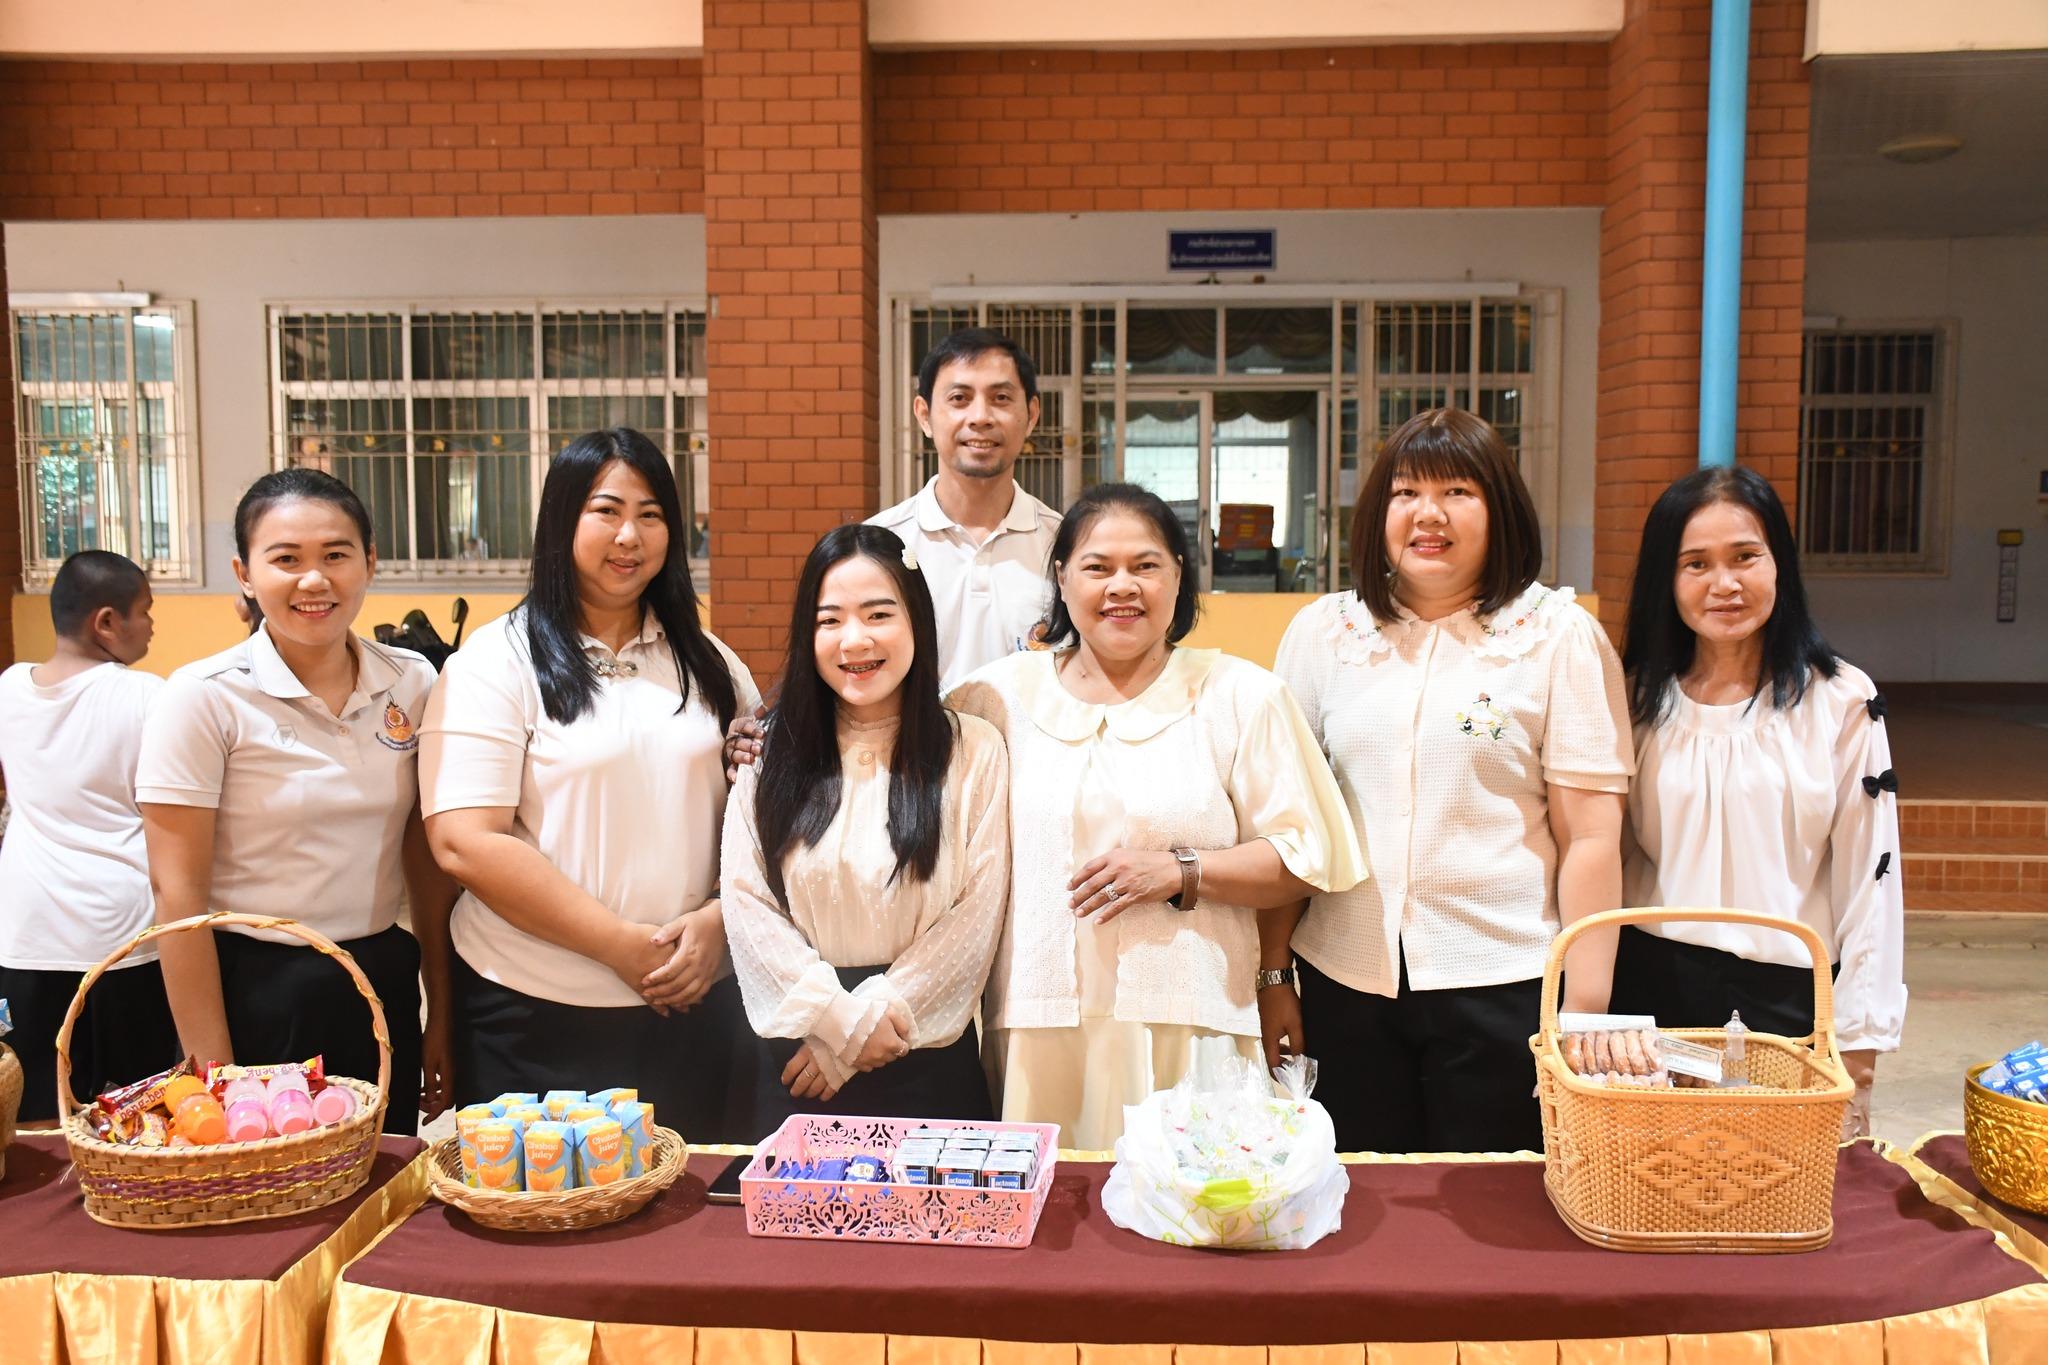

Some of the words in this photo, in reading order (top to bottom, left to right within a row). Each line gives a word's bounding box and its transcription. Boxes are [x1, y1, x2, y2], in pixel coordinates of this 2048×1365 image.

[118, 1085, 169, 1121] beng-ben
[482, 1143, 506, 1153] juicy
[531, 1150, 554, 1161] juicy
